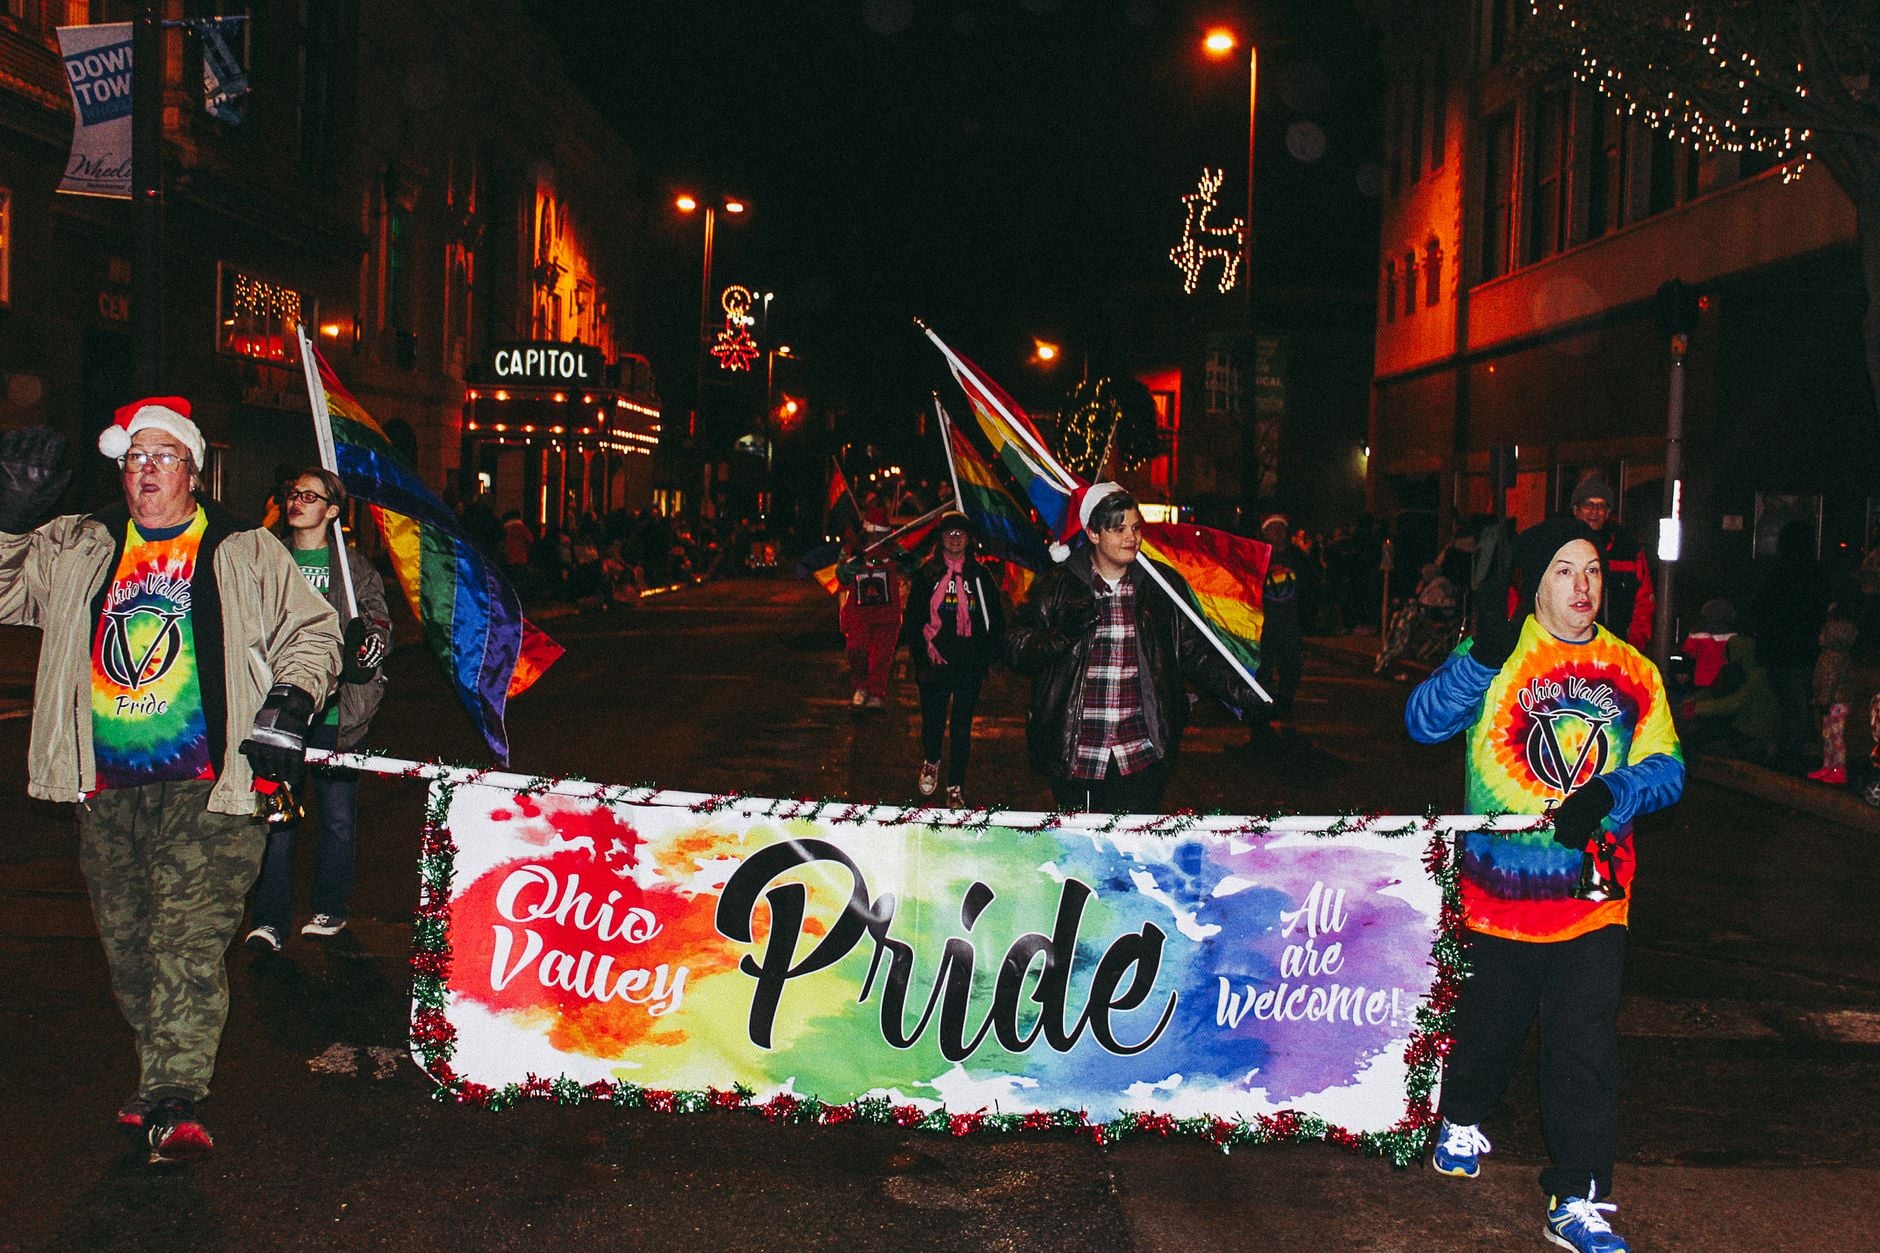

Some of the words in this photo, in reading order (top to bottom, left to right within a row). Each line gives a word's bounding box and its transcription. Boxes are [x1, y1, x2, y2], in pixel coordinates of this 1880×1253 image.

[75, 72, 131, 106] TOW
[495, 349, 588, 378] CAPITOL
[145, 572, 191, 614] Valley
[115, 692, 168, 716] Pride
[1517, 678, 1561, 712] Ohio
[1568, 676, 1621, 719] Valley
[496, 864, 663, 944] Ohio
[1280, 880, 1348, 939] All
[490, 925, 690, 1017] Valley
[715, 838, 1178, 1063] Pride
[1280, 938, 1345, 979] are
[1216, 976, 1404, 1029] Welcome!
